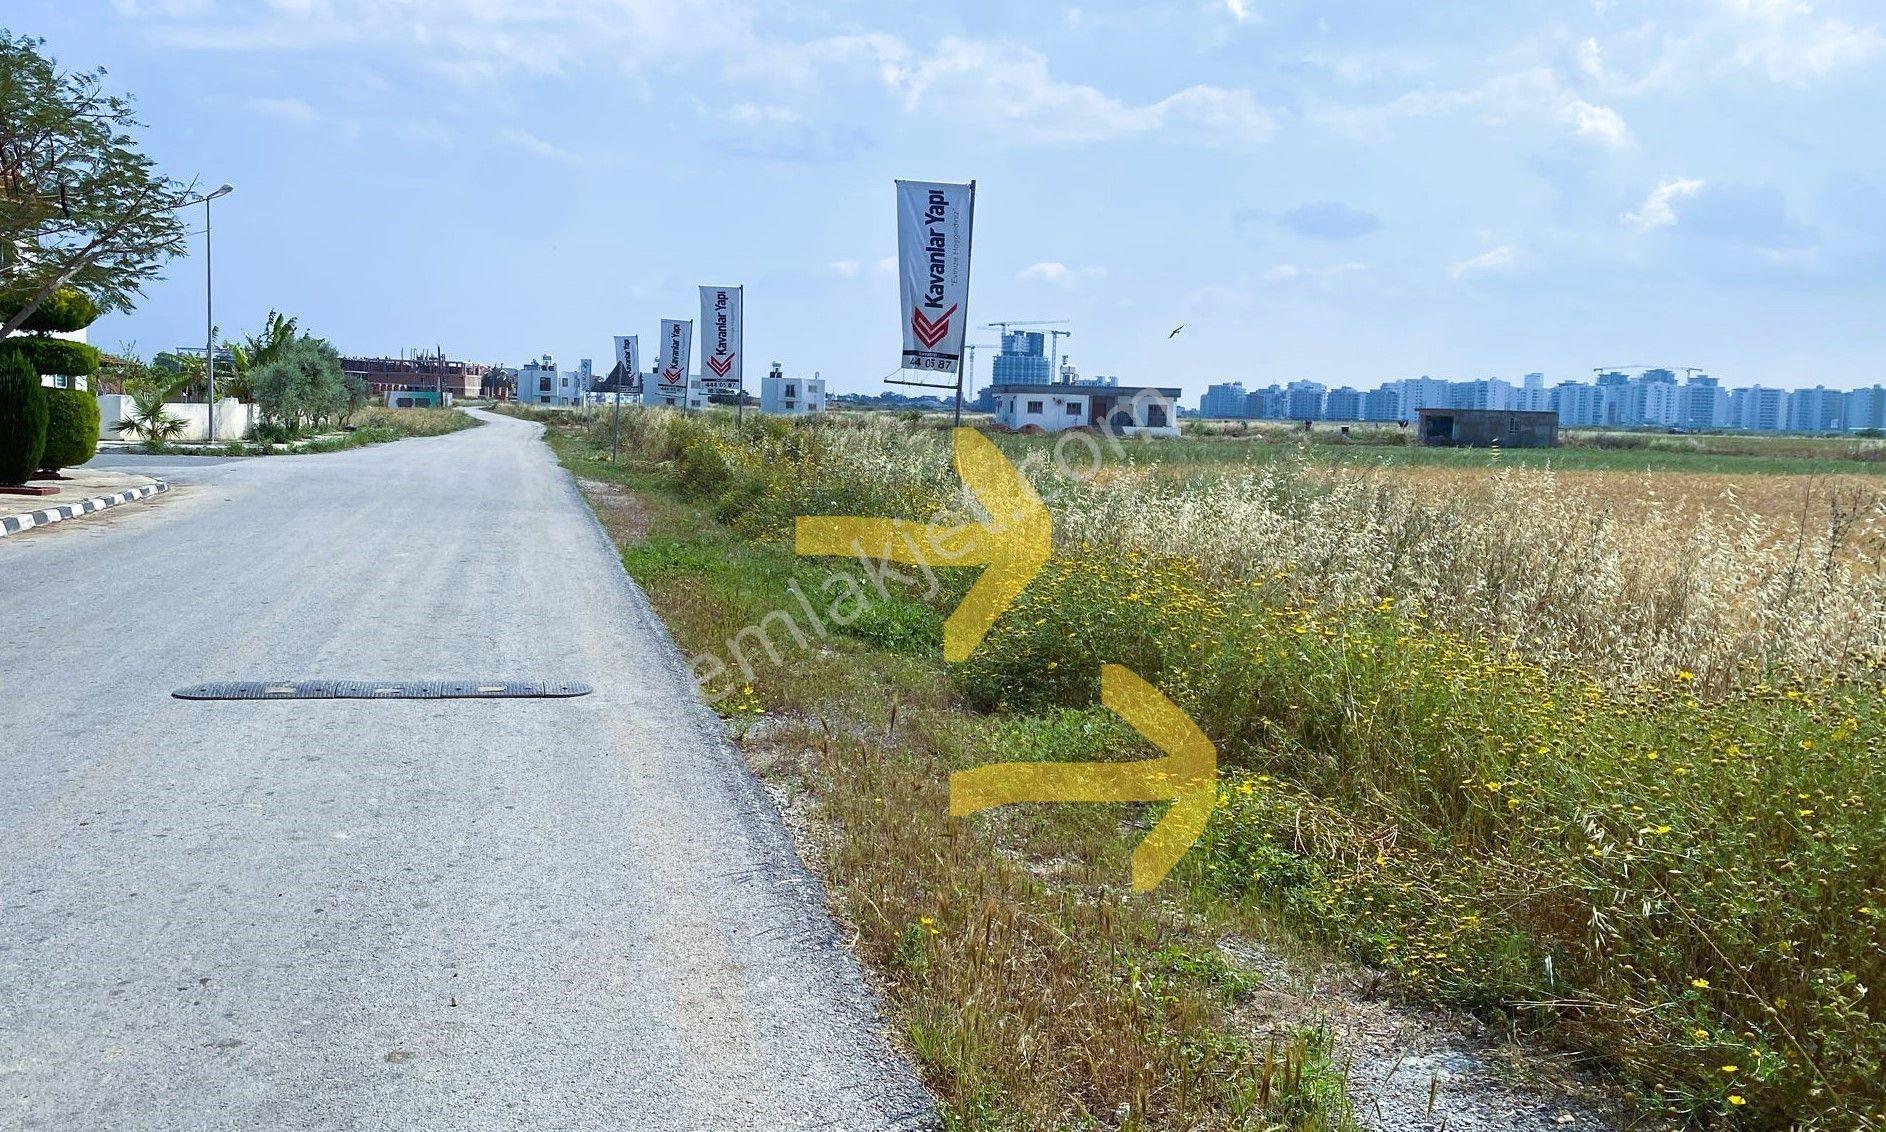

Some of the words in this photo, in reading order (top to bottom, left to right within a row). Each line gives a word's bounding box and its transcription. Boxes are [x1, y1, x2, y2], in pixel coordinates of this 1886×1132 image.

[925, 190, 949, 225] Yapı
[924, 227, 946, 308] Kavanlar
[715, 291, 729, 311] Yapı
[715, 313, 727, 356] Kavanlar
[925, 358, 936, 368] 05
[938, 360, 952, 370] 87
